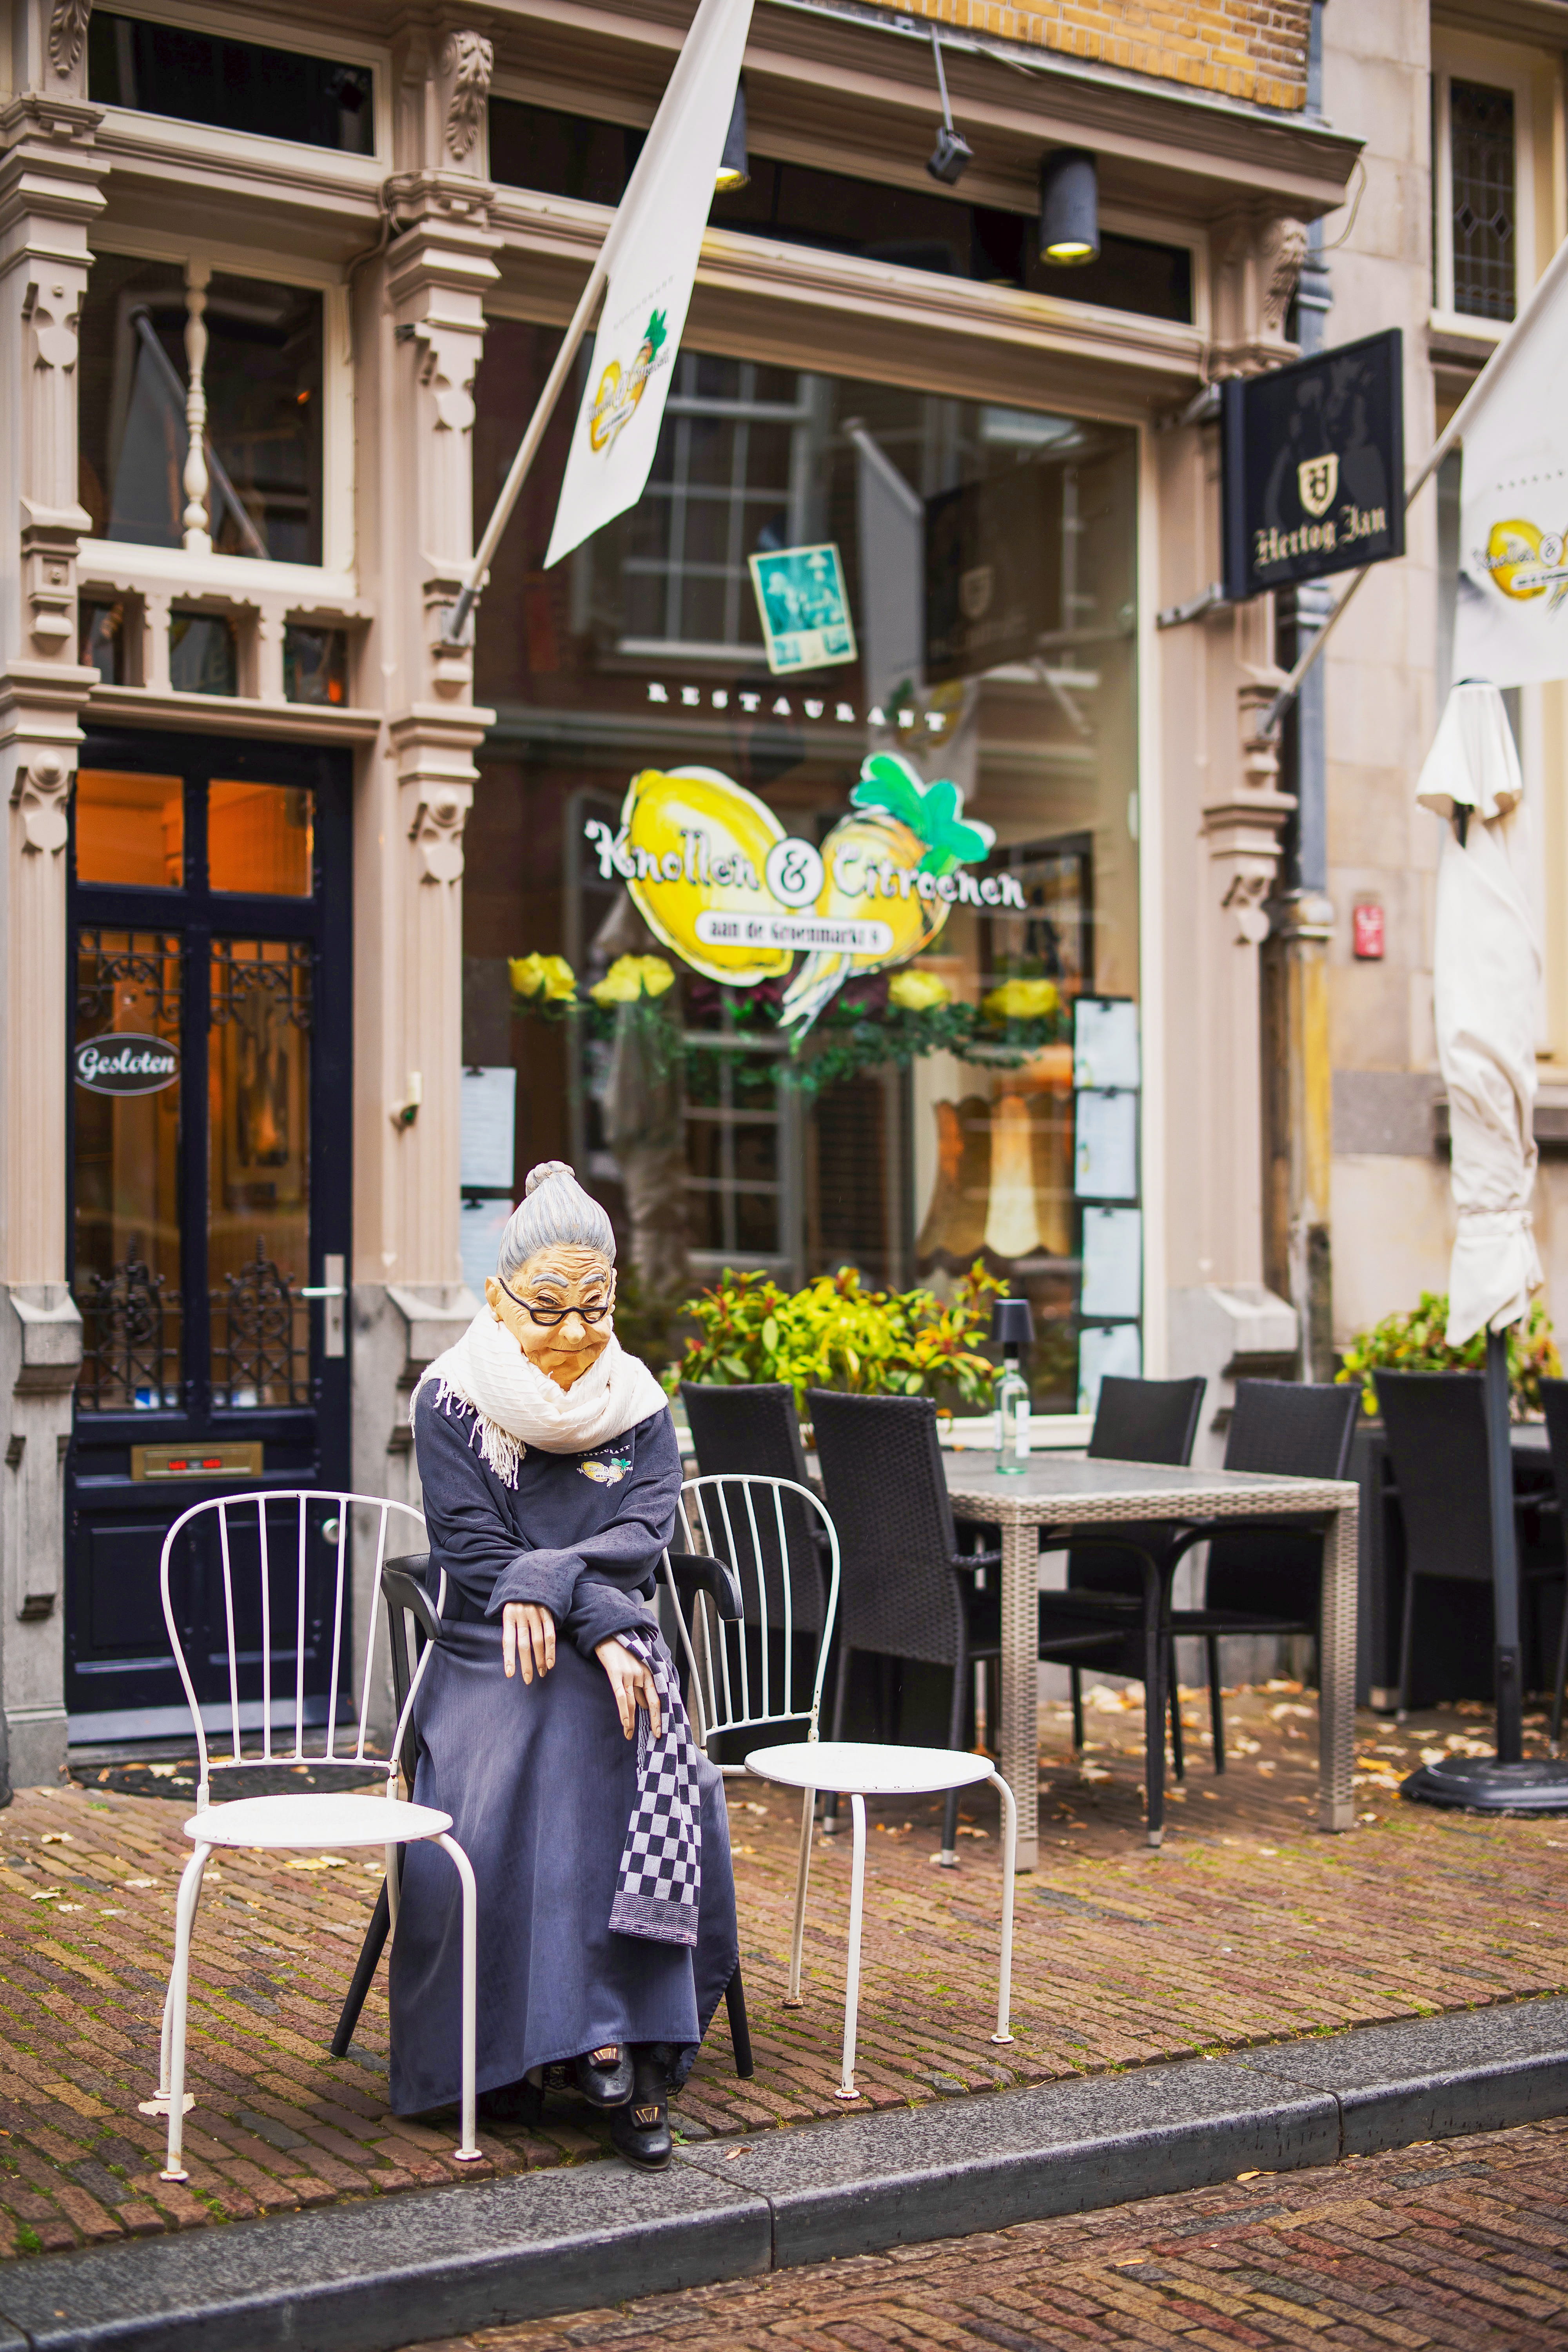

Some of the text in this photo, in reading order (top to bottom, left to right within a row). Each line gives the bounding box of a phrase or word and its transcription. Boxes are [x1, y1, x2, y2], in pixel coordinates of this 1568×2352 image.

[1254, 504, 1387, 567] Hertog Jan
[648, 682, 946, 732] RESTAURANT
[584, 820, 1027, 910] Knollen & Citroenen
[711, 922, 739, 937] aan
[748, 922, 763, 938] de
[78, 1047, 176, 1082] Gesloten
[577, 1445, 630, 1457] RESTAURANT
